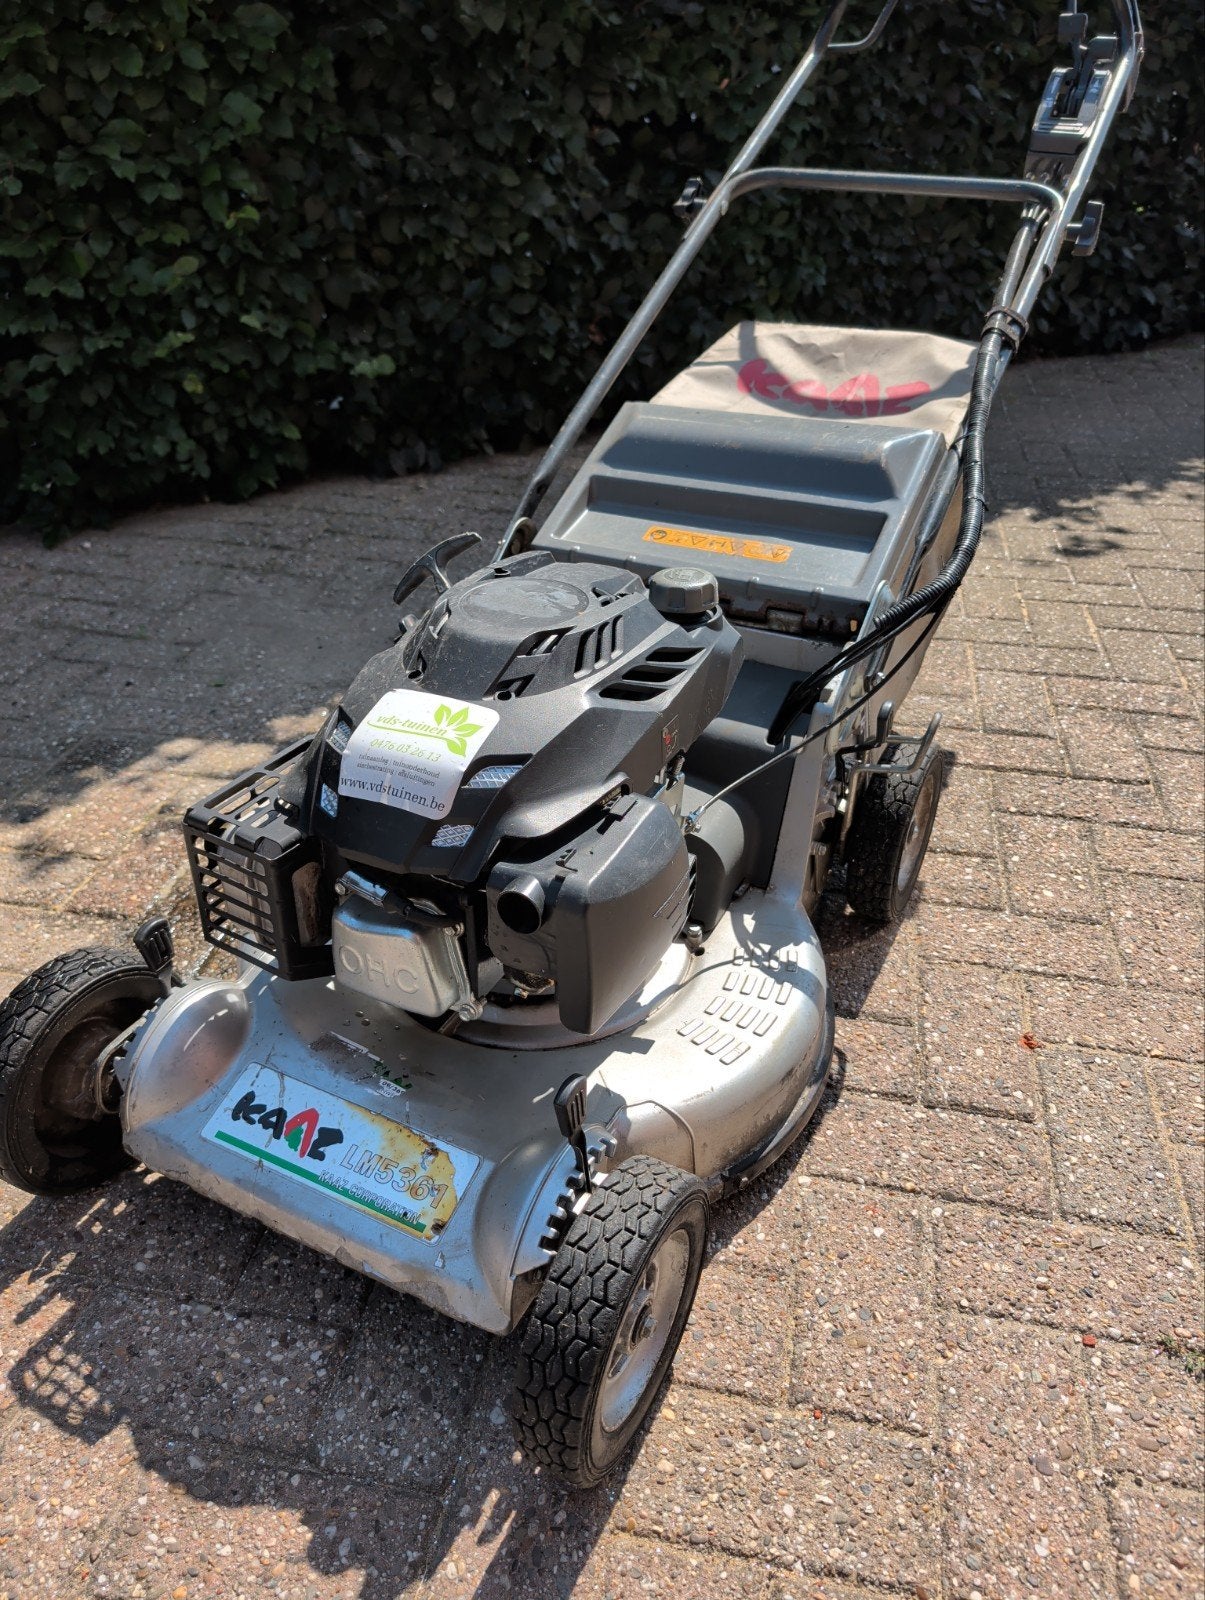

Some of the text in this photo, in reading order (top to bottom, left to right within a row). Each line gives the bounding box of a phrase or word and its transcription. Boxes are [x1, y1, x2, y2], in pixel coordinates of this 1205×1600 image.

[376, 714, 447, 736] vds-tuinen
[340, 776, 445, 811] www.vdstuinen.be
[339, 945, 419, 994] OHC
[231, 1090, 344, 1161] KAAZ
[317, 1169, 422, 1224] KAAZ CORPORATION
[339, 1144, 449, 1209] LM5361
